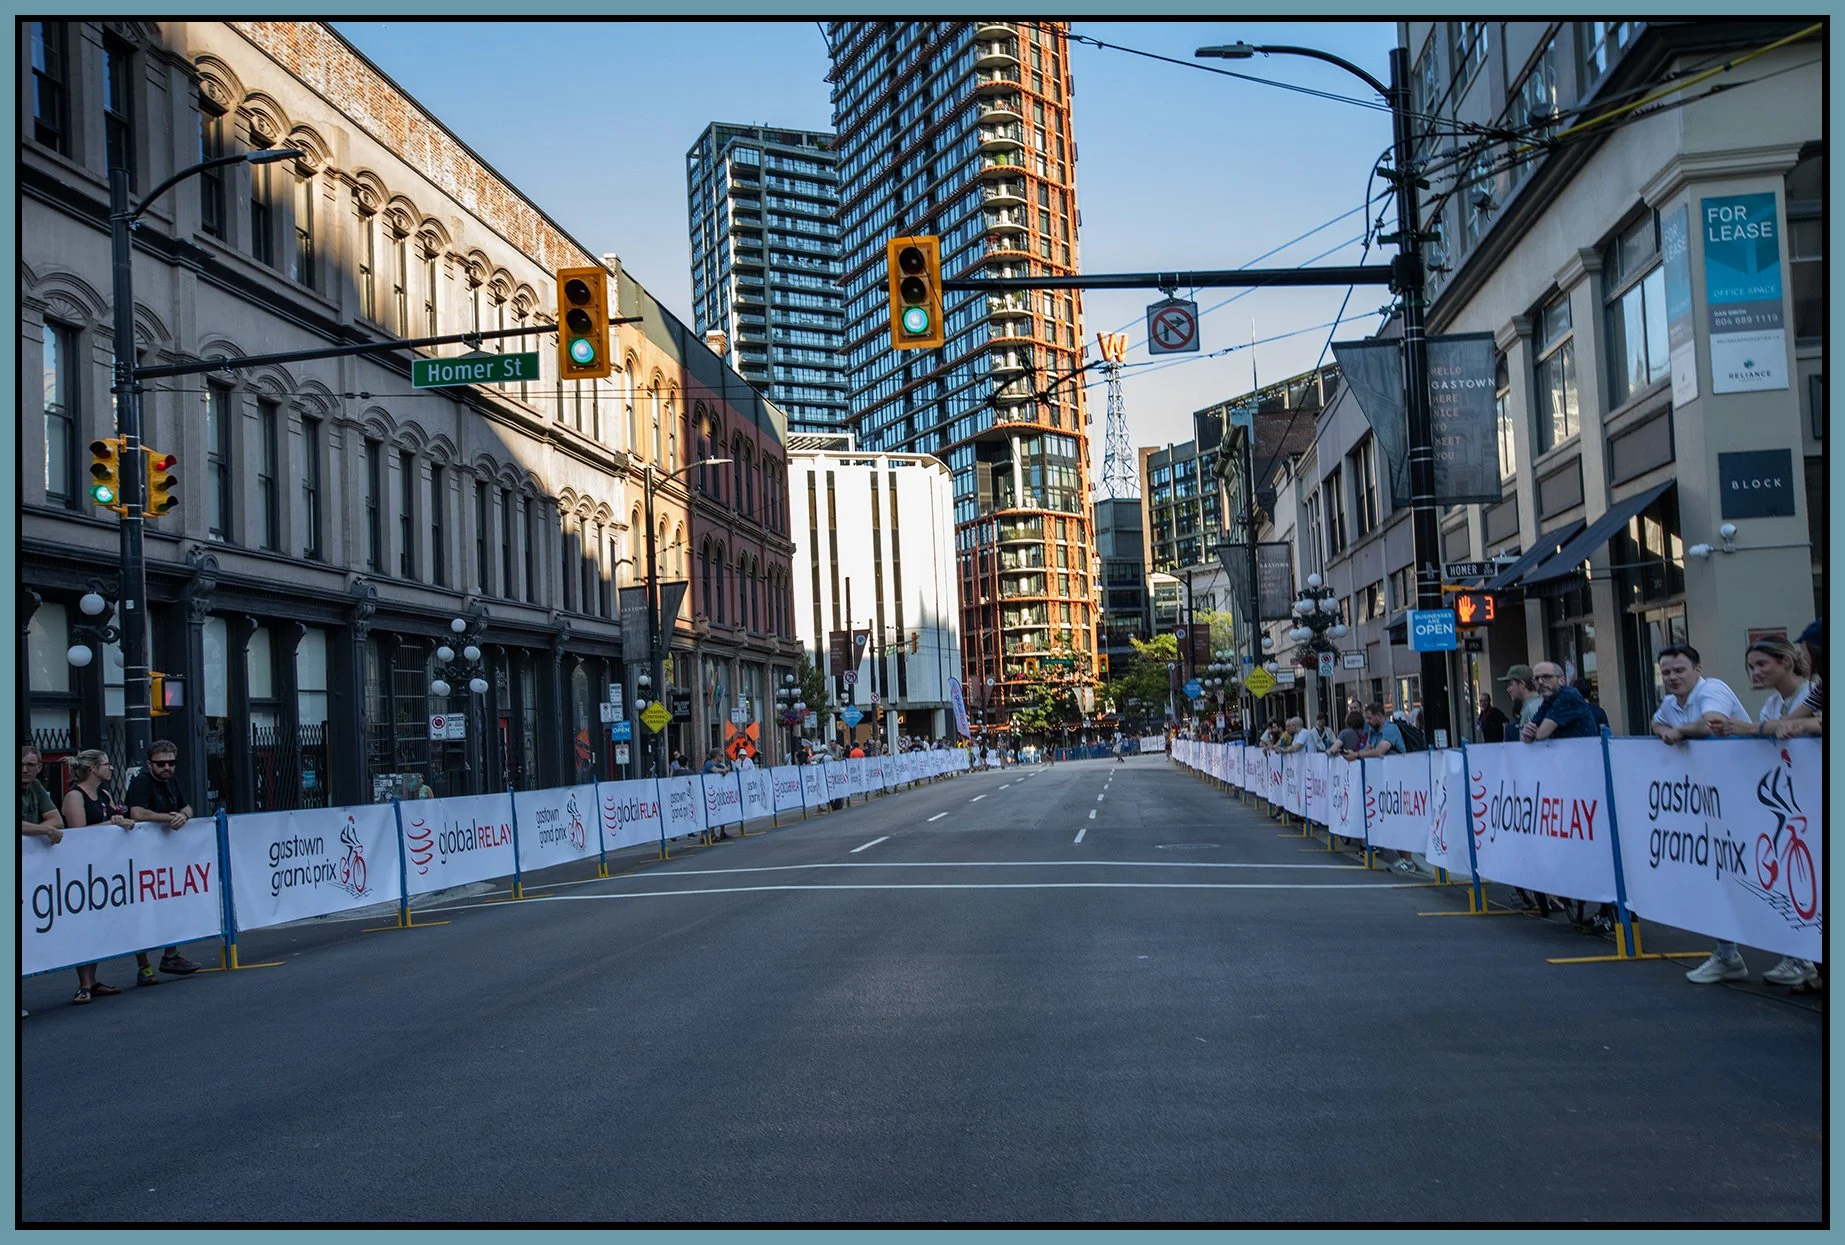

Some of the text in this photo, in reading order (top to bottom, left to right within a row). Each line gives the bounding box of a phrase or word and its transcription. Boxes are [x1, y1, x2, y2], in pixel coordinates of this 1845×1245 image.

[1707, 205, 1747, 223] FOR
[1709, 221, 1773, 242] LEASE
[1096, 331, 1128, 363] W
[428, 358, 522, 382] Homer St
[1728, 370, 1772, 380] RELIANCE
[1431, 377, 1496, 390] GASTOWN
[1731, 477, 1782, 490] BLOCK
[1449, 564, 1478, 576] HOMER
[1484, 596, 1495, 620] 3
[1415, 623, 1453, 636] OPEN
[1378, 780, 1428, 823] gbalRLAY
[1648, 774, 1721, 821] gastown
[1490, 779, 1597, 843] globalRELAY
[269, 834, 324, 868] gastown
[1649, 822, 1747, 880] grand prix
[271, 858, 337, 897] grand prix
[32, 858, 211, 933] globalRELAY
